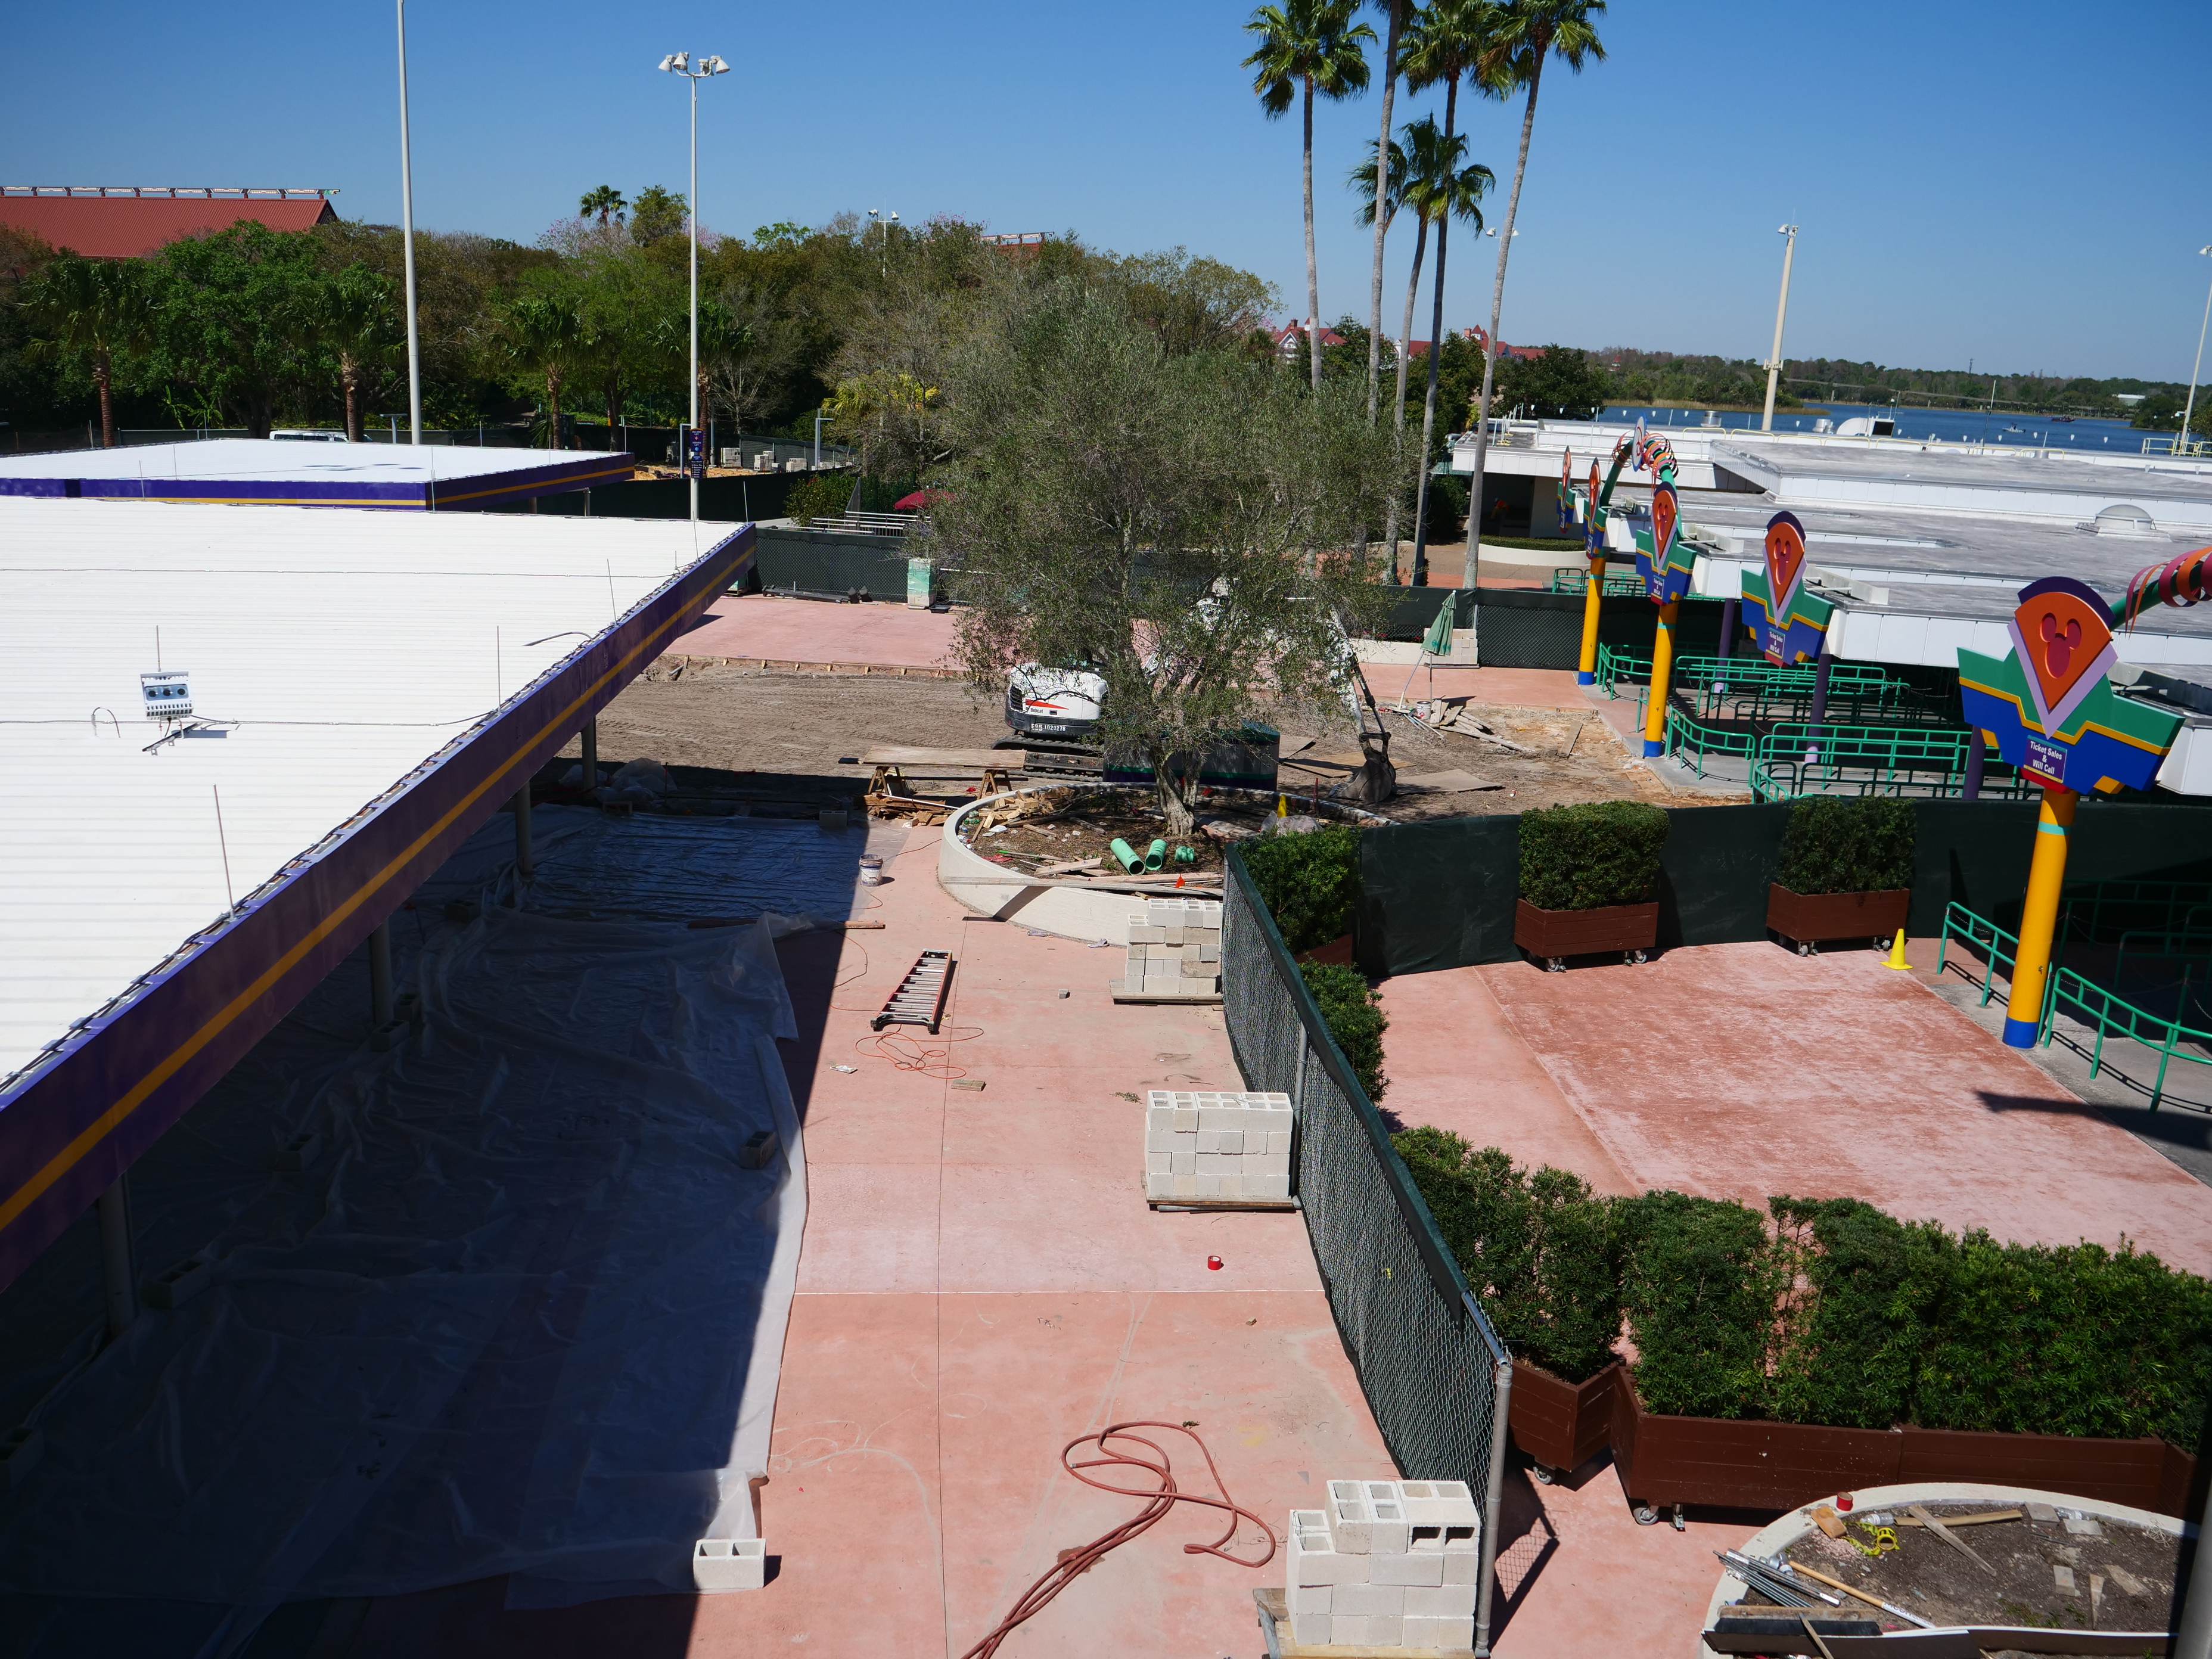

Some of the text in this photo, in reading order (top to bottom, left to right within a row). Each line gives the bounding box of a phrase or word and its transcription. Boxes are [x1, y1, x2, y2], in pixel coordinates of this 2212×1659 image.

[2030, 741, 2062, 760] Ticket Sales
[2042, 754, 2047, 763] &
[2033, 759, 2055, 775] Will Call
